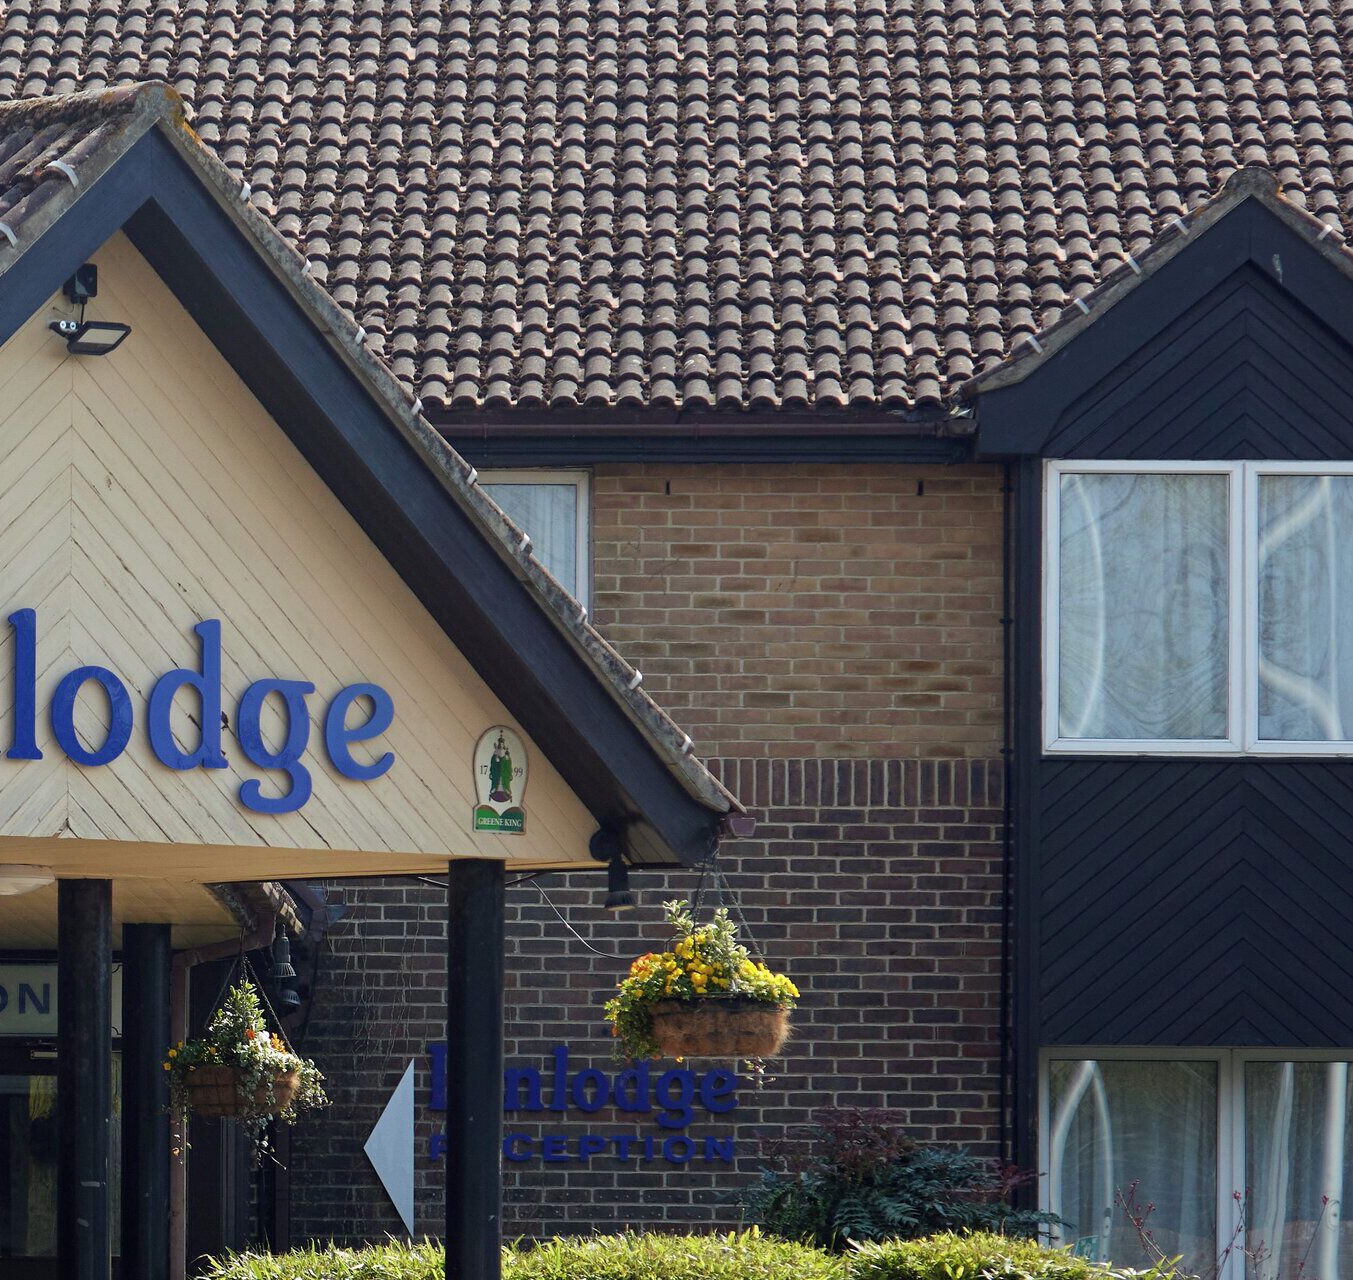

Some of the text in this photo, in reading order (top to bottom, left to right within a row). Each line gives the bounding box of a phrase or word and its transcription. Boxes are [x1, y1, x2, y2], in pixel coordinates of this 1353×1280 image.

[480, 765, 488, 775] 17
[478, 817, 522, 827] GREENE KING
[428, 1044, 740, 1129] Inlodge
[430, 1134, 734, 1163] RCEPTION
